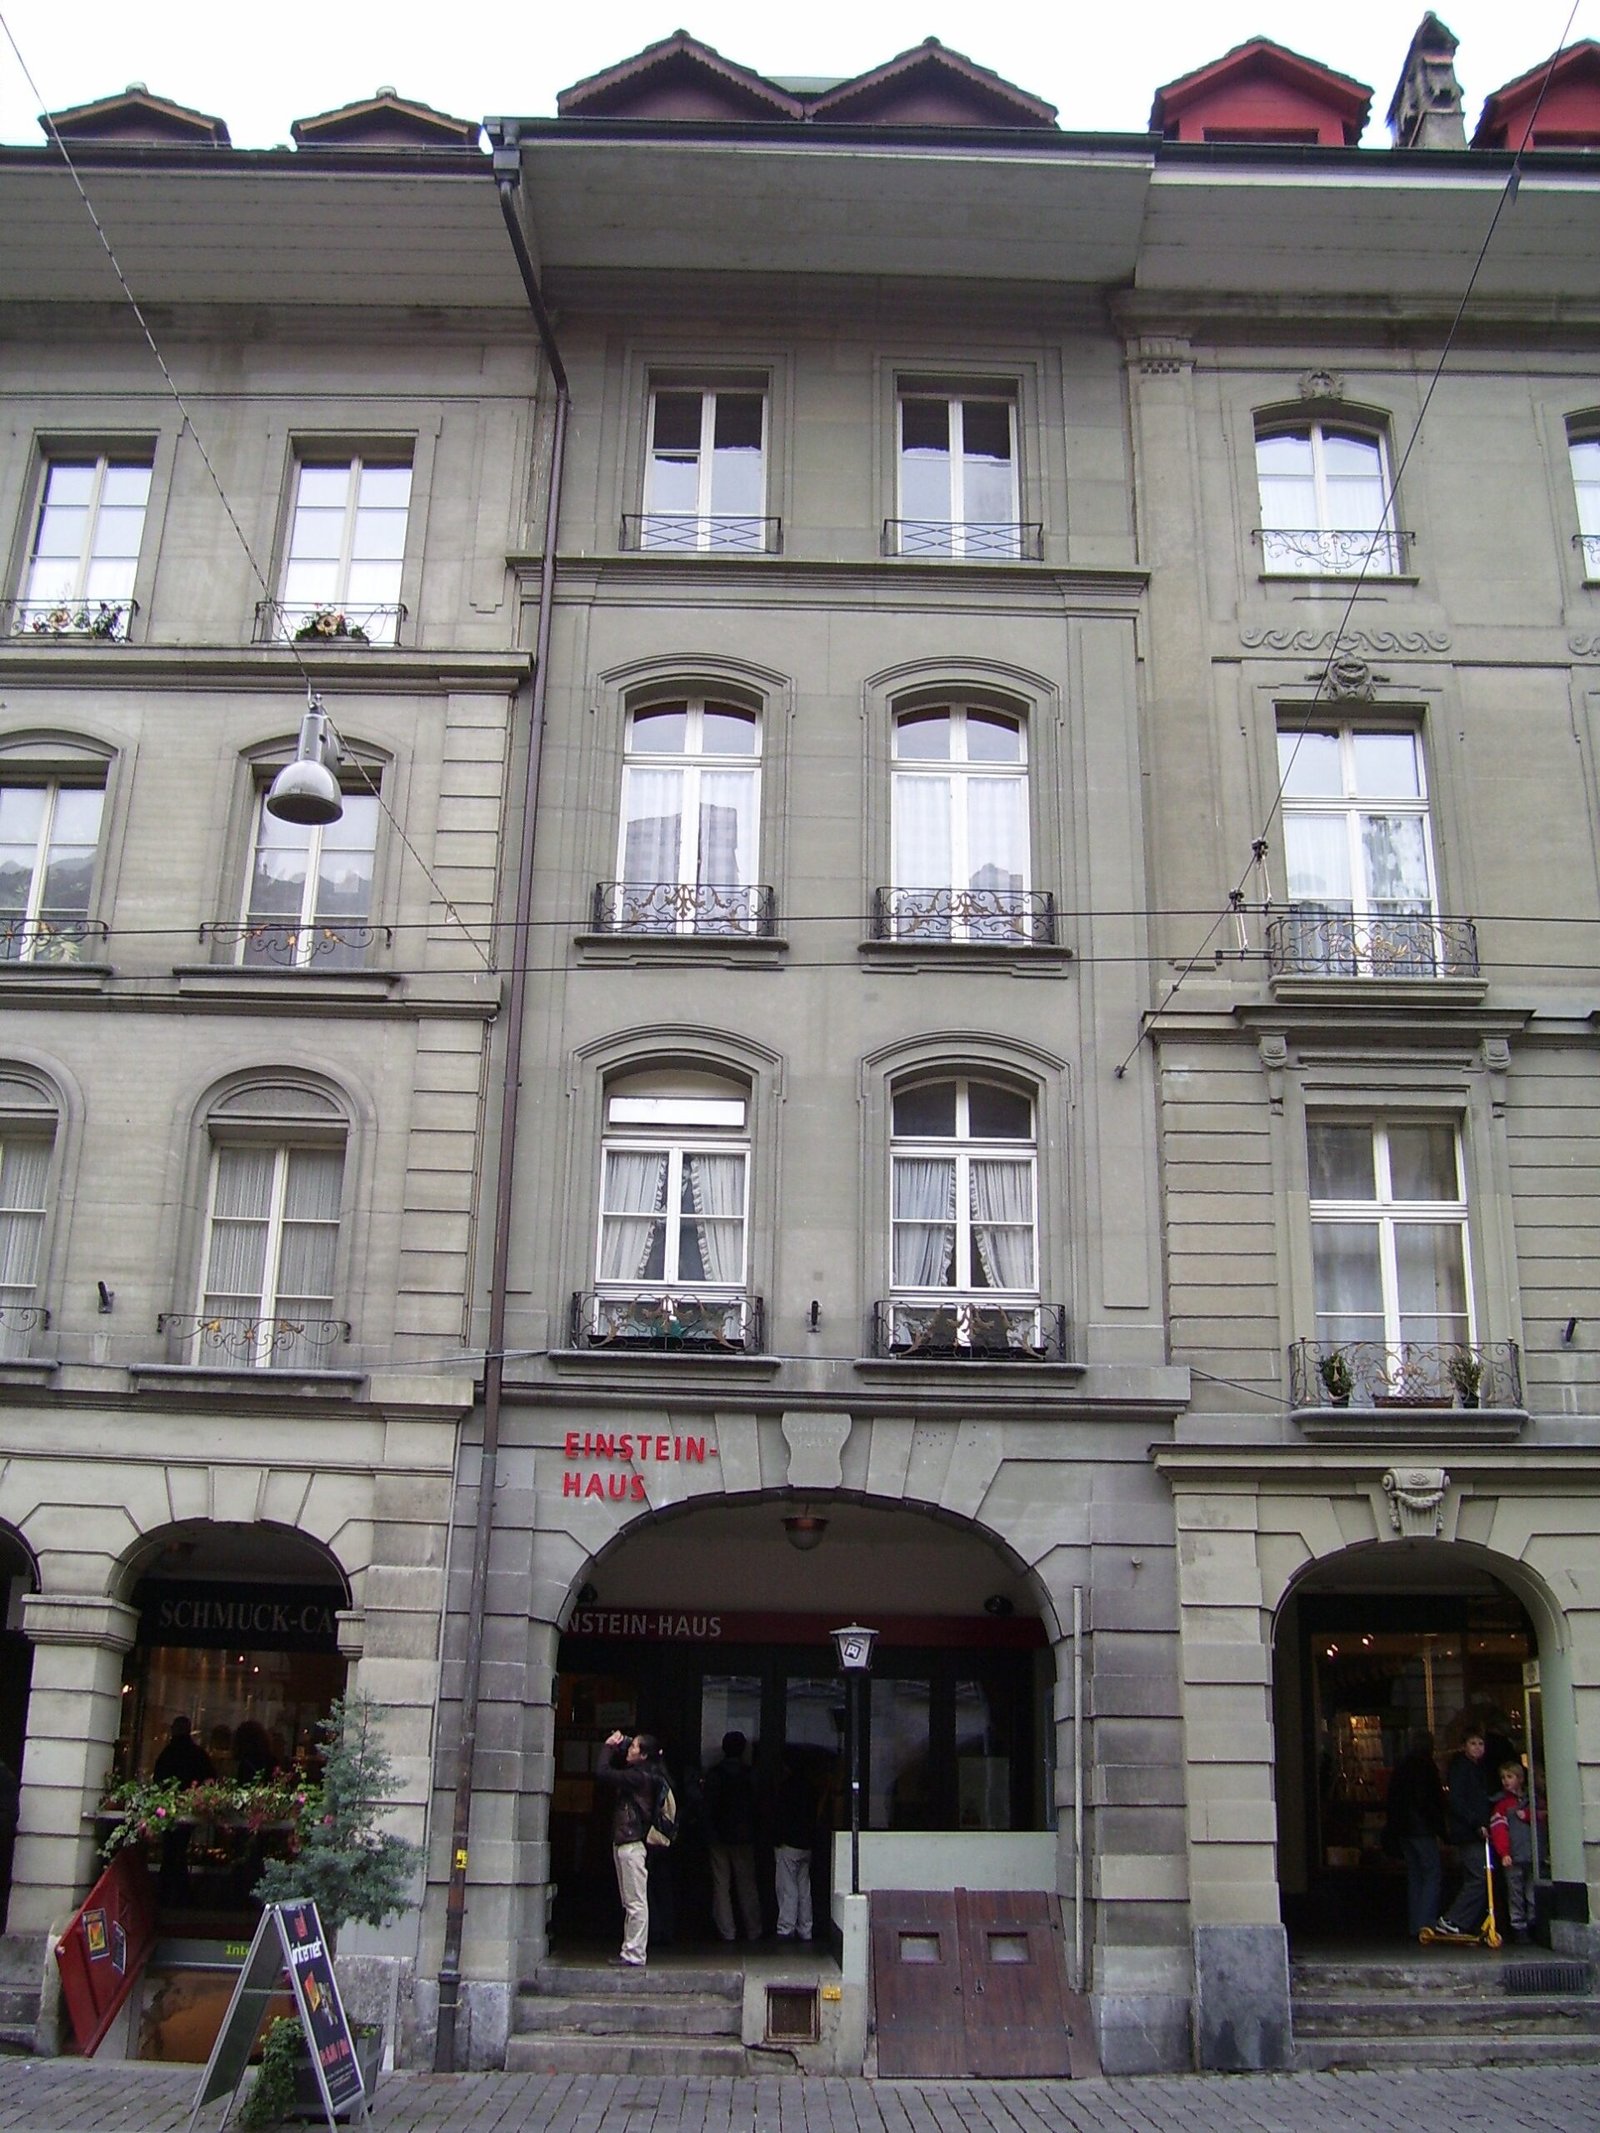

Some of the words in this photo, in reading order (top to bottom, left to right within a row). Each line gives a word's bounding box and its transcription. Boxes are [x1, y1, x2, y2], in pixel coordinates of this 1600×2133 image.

[565, 1432, 718, 1464] EINSTEIN-
[563, 1471, 646, 1501] HAUS
[290, 1936, 322, 1966] internet
